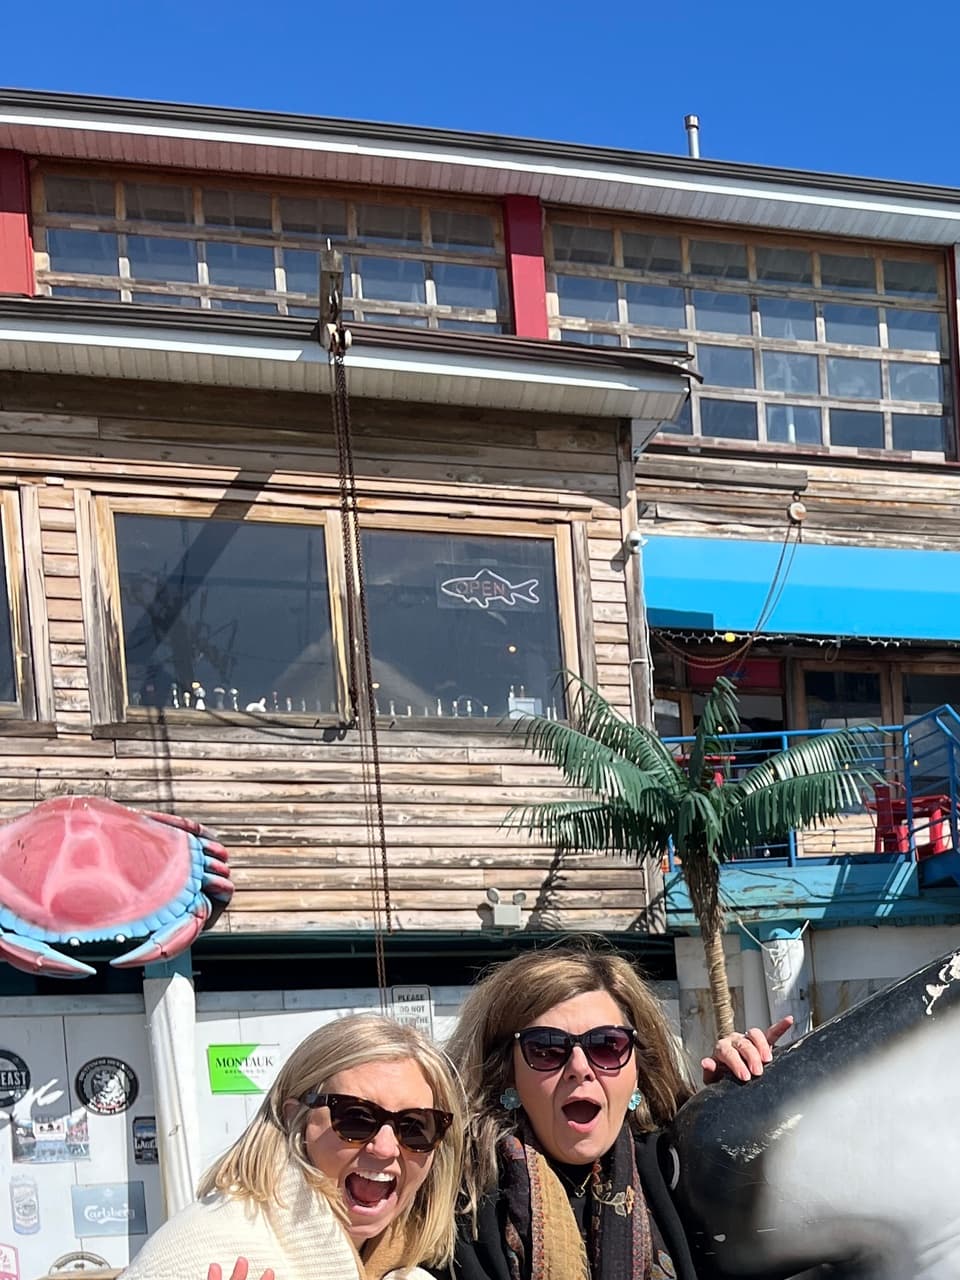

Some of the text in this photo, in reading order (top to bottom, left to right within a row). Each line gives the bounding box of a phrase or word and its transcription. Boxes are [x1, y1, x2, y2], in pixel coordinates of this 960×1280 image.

[455, 581, 505, 596] OPEN
[216, 1056, 273, 1068] MONTAUK
[84, 1204, 136, 1223] Carlsberg
